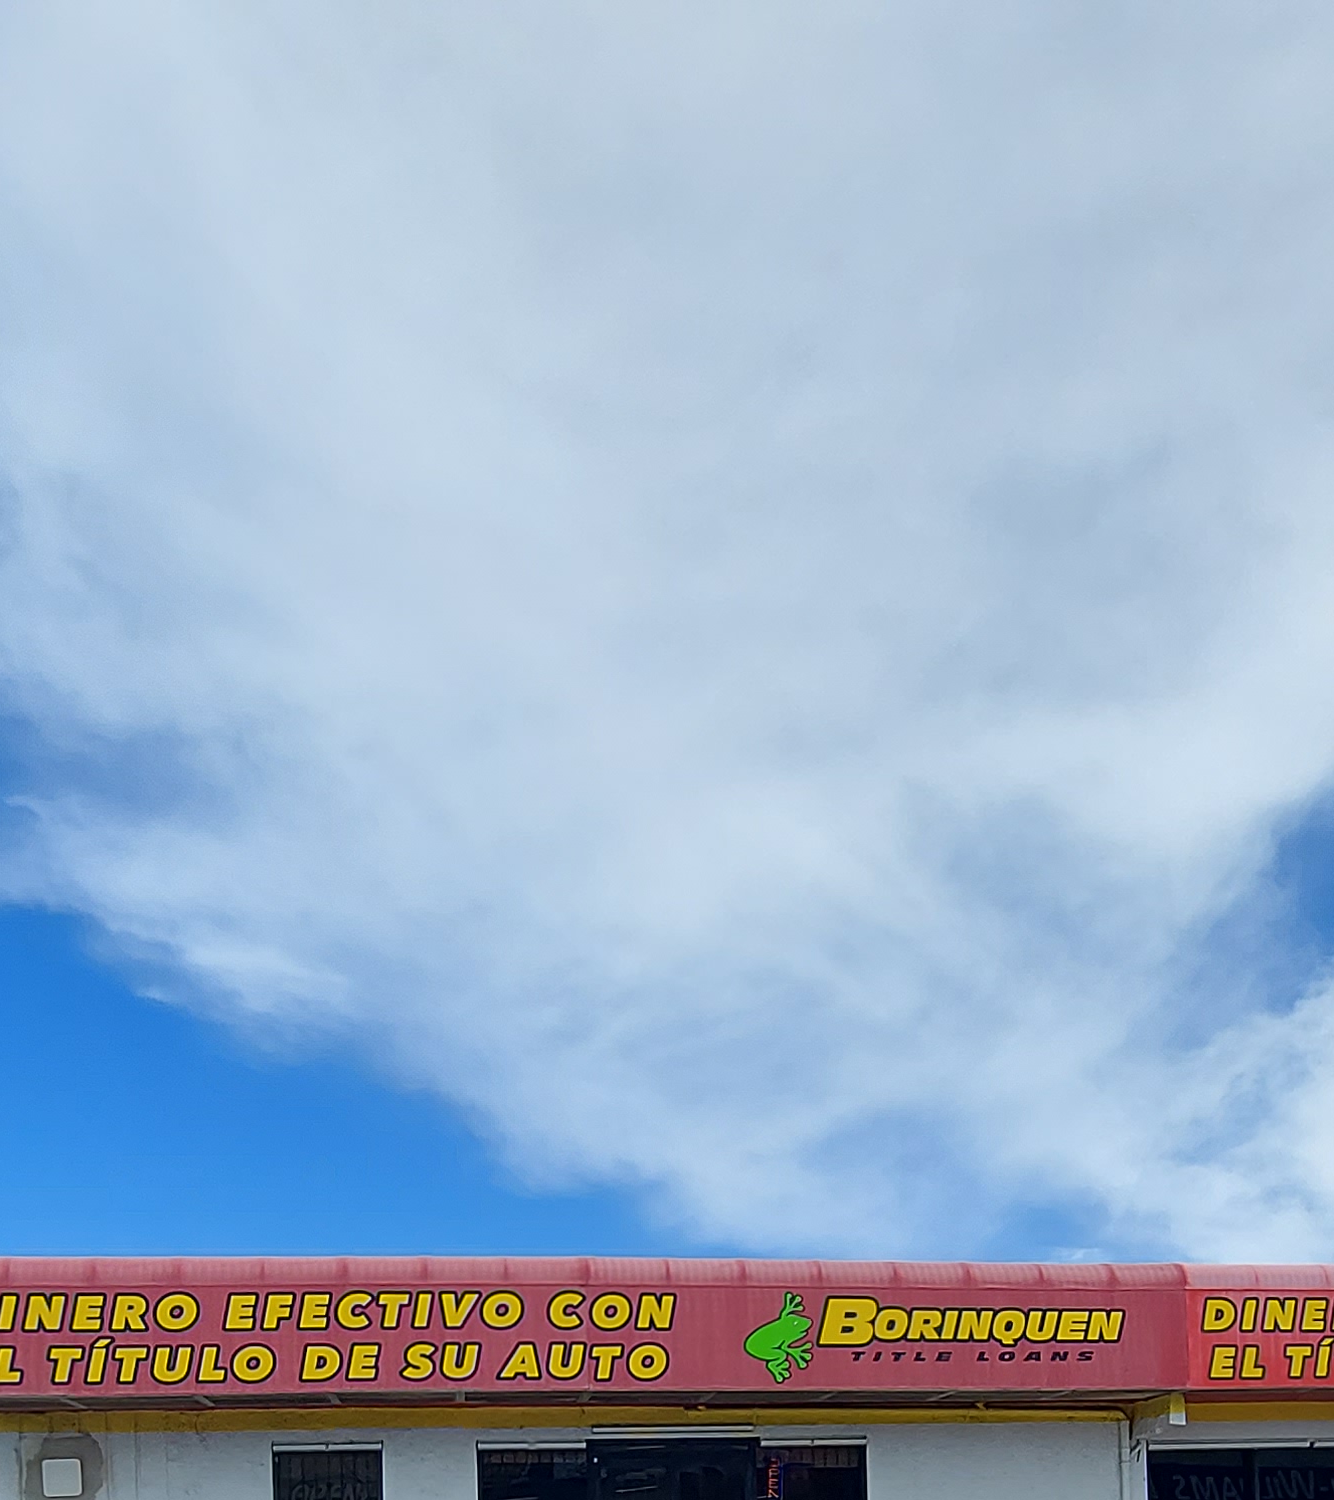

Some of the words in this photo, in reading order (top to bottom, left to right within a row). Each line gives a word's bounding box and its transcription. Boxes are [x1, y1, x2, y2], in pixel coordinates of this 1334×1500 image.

[224, 1289, 525, 1334] EFECTIVO
[547, 1291, 677, 1333] CON
[816, 1296, 1126, 1349] BORINQUEN
[48, 1336, 278, 1385] TÍTULO
[299, 1341, 380, 1382] DE
[400, 1341, 482, 1382] SU
[496, 1341, 672, 1382] AUTO
[849, 1351, 954, 1363] TITLE
[975, 1350, 1096, 1363] LOANS
[1207, 1344, 1266, 1380] EL
